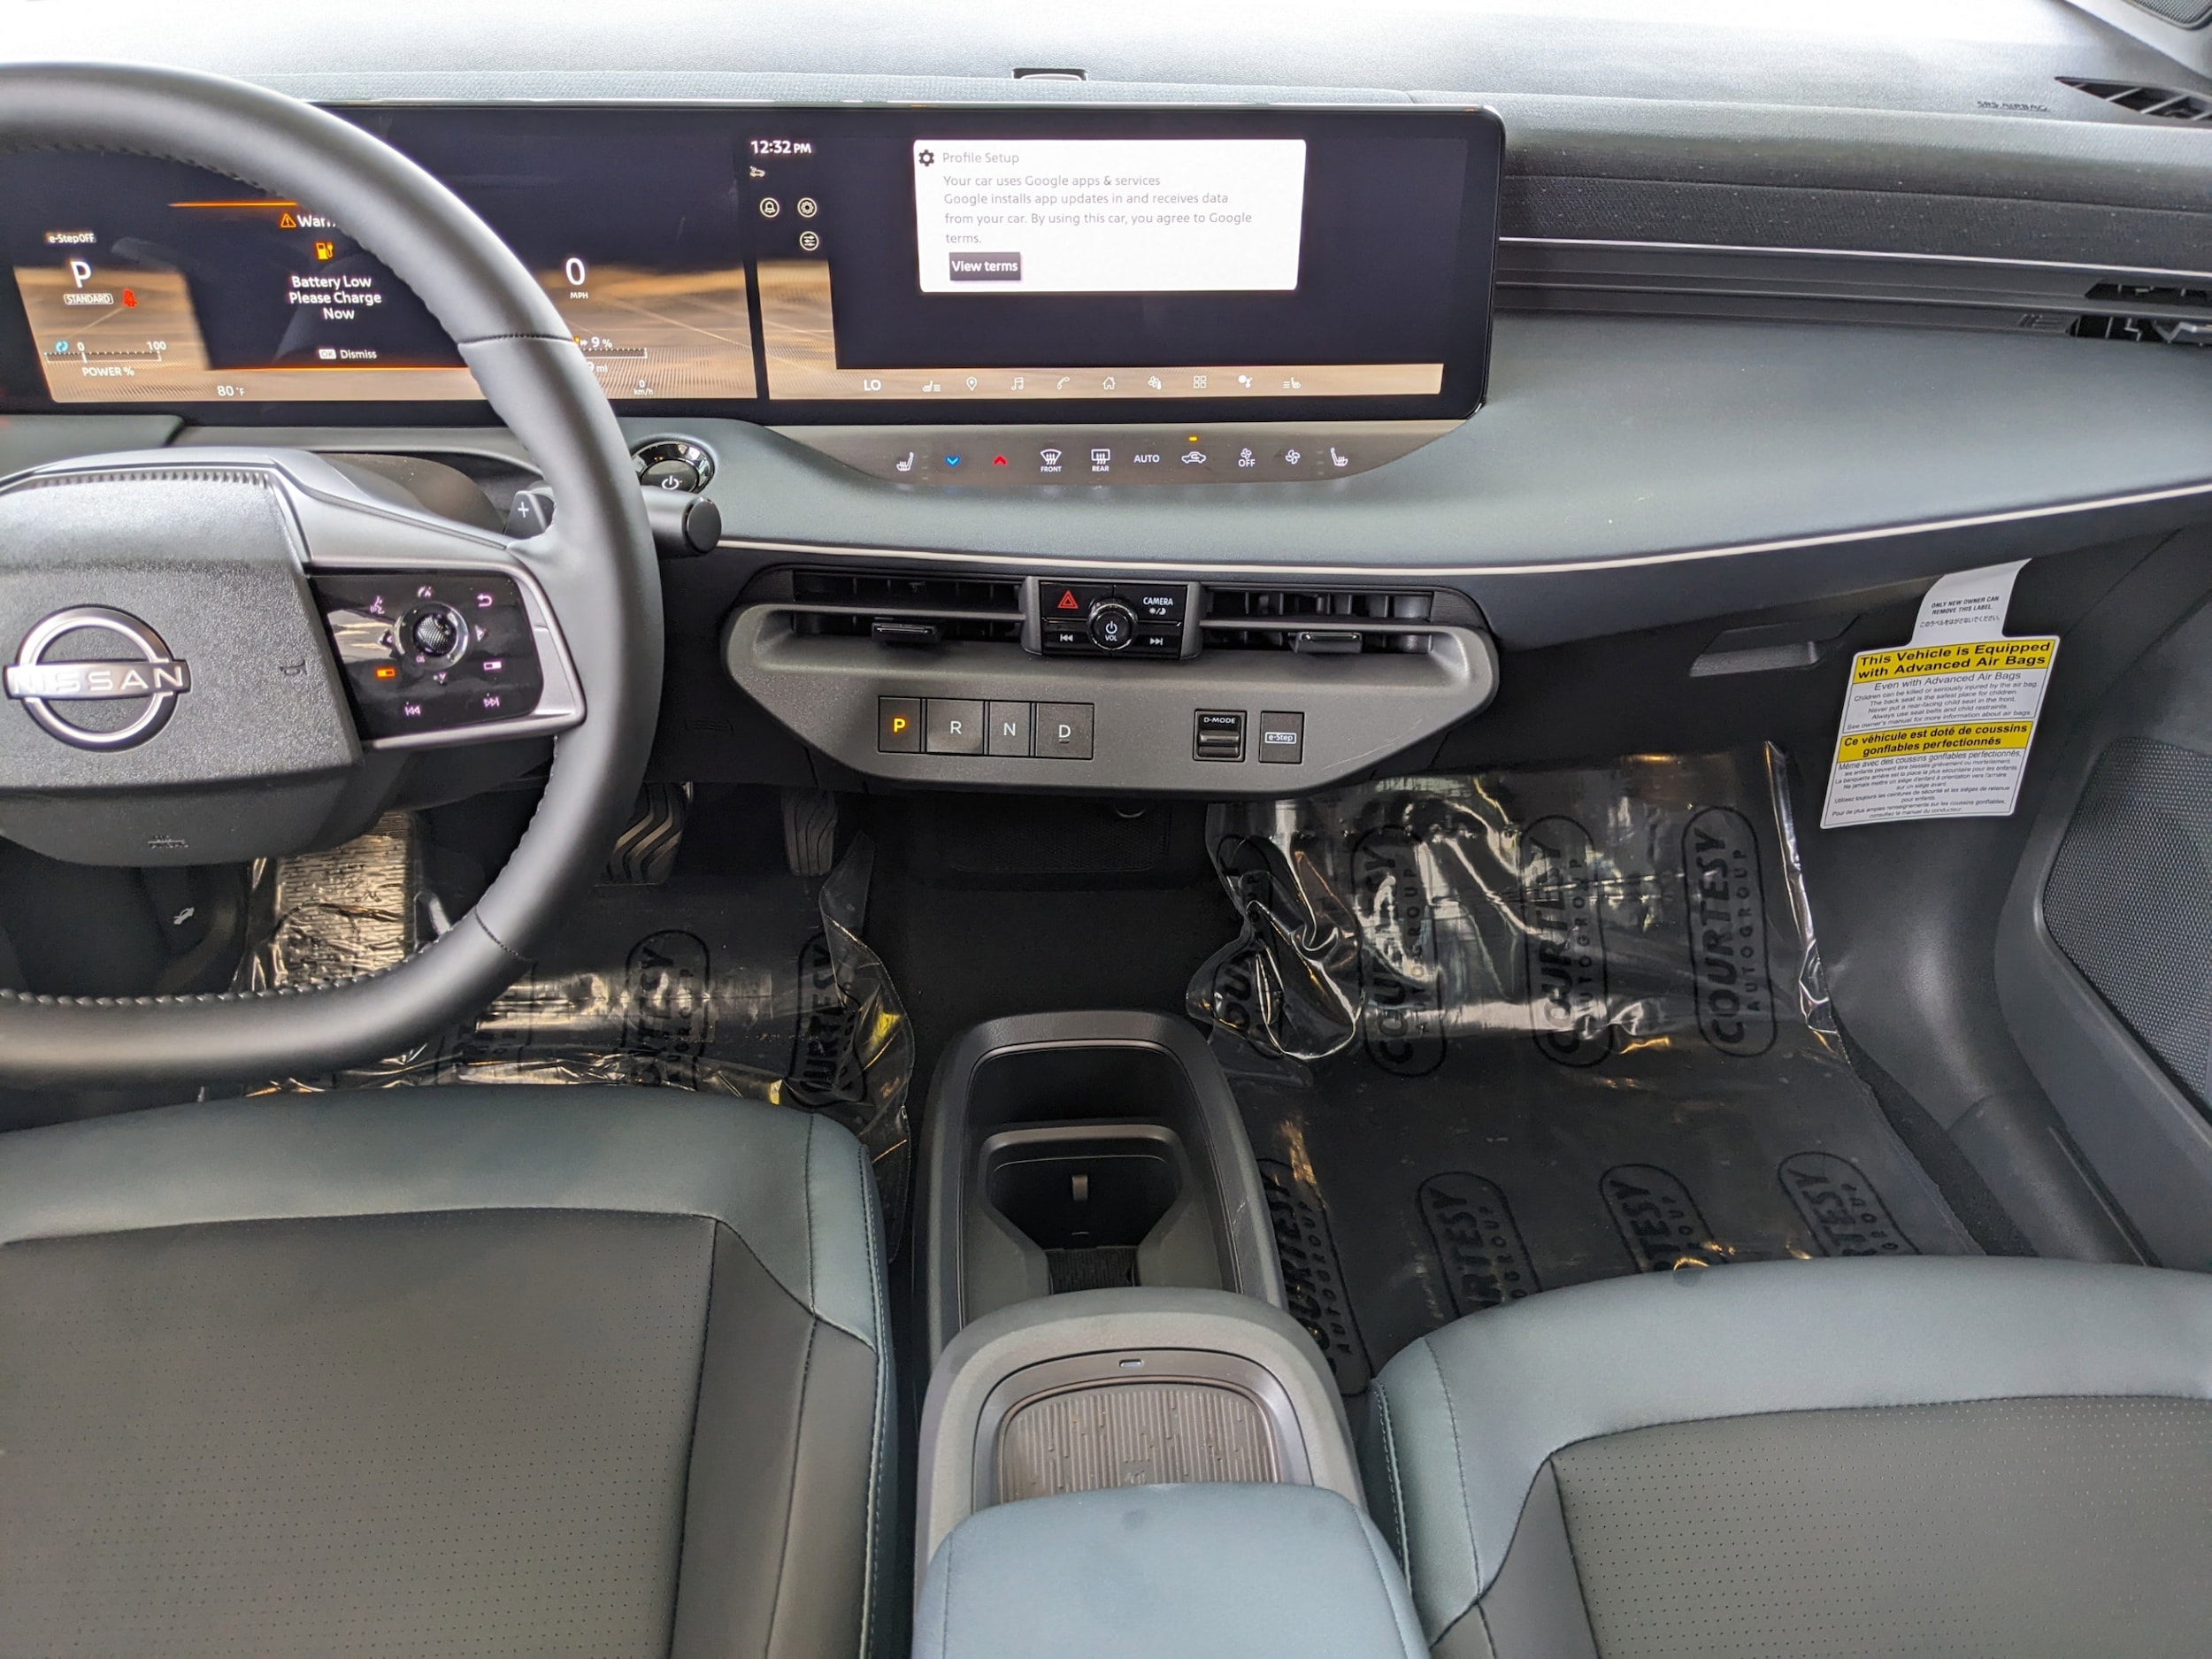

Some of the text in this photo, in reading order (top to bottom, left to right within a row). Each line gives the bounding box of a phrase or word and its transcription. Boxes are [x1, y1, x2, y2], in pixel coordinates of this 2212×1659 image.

[751, 140, 812, 154] 12:32 PM
[942, 152, 1019, 165] Profile Setup
[943, 176, 971, 186] Your
[1025, 175, 1069, 188] Google
[1072, 178, 1100, 188] apps
[1103, 175, 1111, 186] &
[1115, 175, 1161, 186] services
[944, 193, 1228, 206] Google installs app updates in and receives data
[297, 214, 336, 228] War
[945, 213, 973, 223] from
[977, 215, 1003, 226] your
[1032, 213, 1045, 226] By
[1048, 213, 1079, 226] using
[1084, 213, 1104, 223] this
[1108, 215, 1127, 225] car,
[1131, 214, 1152, 225] you
[1156, 214, 1189, 225] agree
[1194, 213, 1205, 223] to
[1210, 212, 1252, 225] Google
[946, 234, 982, 243] terms.
[565, 257, 586, 285] 0
[952, 260, 1018, 272] View terms
[71, 261, 91, 288] P
[292, 276, 372, 290] Battery Low
[66, 295, 111, 303] STANDARD
[289, 292, 382, 306] Please Charge
[323, 308, 354, 319] Now
[77, 342, 85, 351] 0
[147, 342, 166, 350] 100
[340, 349, 377, 359] Dismiss
[81, 366, 134, 377] POWER %
[218, 386, 234, 396] 80
[864, 379, 881, 391] LO
[1239, 458, 1256, 467] OFF
[1143, 596, 1173, 605] CAMERA
[1862, 642, 2050, 665] This Vehicle is Equipped
[1858, 656, 2046, 679] with Advanced Air Bags
[14, 667, 183, 694] NISSAN
[1874, 681, 1899, 690] Even
[1902, 679, 1922, 687] with
[1924, 673, 1975, 685] Advanced
[894, 718, 906, 732] P
[950, 721, 962, 734] R
[1004, 723, 1016, 736] N
[1059, 725, 1071, 738] D
[1862, 732, 1907, 743] véhicule
[1931, 727, 1955, 737] doté
[1975, 724, 2027, 733] coussins
[1863, 737, 2001, 757] gonflables perfectionnés
[1929, 752, 1966, 763] gonflables
[1694, 827, 1746, 1044] COURTESY
